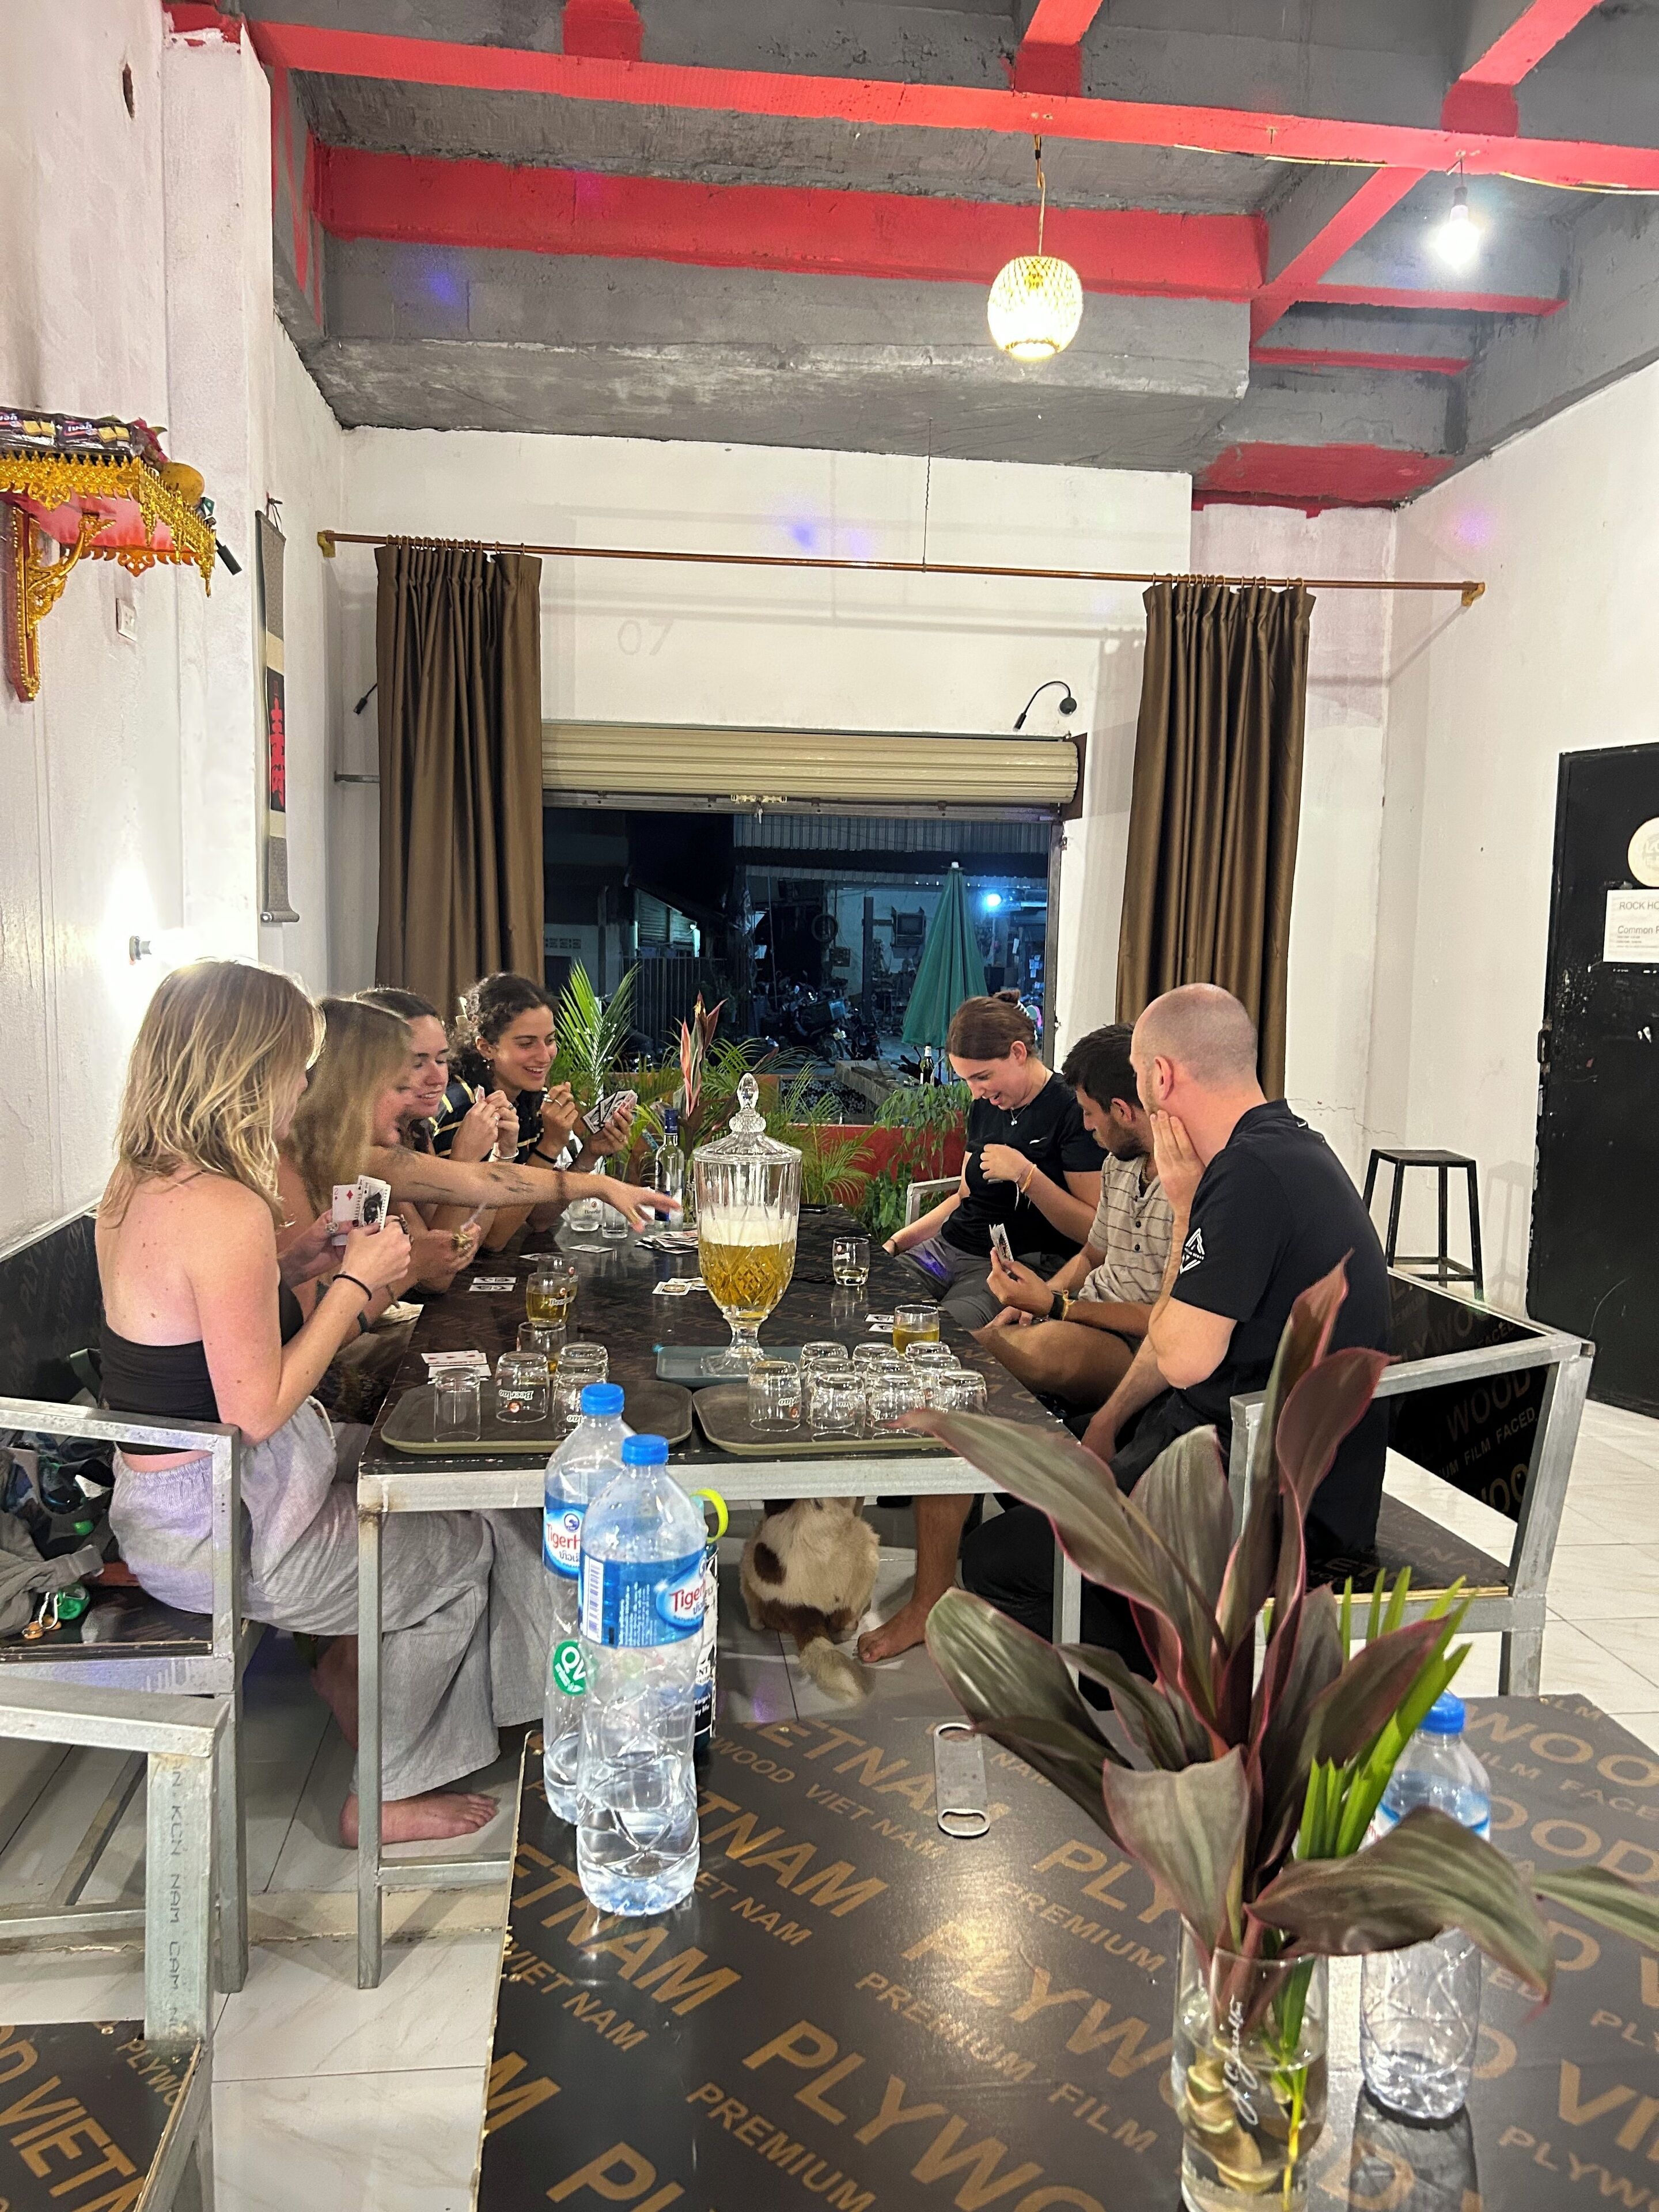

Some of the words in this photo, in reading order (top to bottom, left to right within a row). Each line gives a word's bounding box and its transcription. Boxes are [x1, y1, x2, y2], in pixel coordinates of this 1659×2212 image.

[1618, 925, 1653, 935] Common
[1619, 901, 1645, 910] ROCK
[499, 1389, 534, 1400] Beerlao
[806, 1783, 874, 1820] VIET
[872, 1818, 949, 1859] NAM
[171, 1874, 181, 1922] NAM
[698, 1786, 888, 1918] TNAM
[902, 1919, 1178, 2107] PLYW
[730, 1895, 813, 1948] NAM
[854, 1971, 1037, 2082] PREMIUM
[1047, 2080, 1159, 2154] FILM
[562, 1990, 649, 2052] NAM
[686, 2082, 876, 2212] PREMIUM
[1498, 2125, 1659, 2212] PLYW
